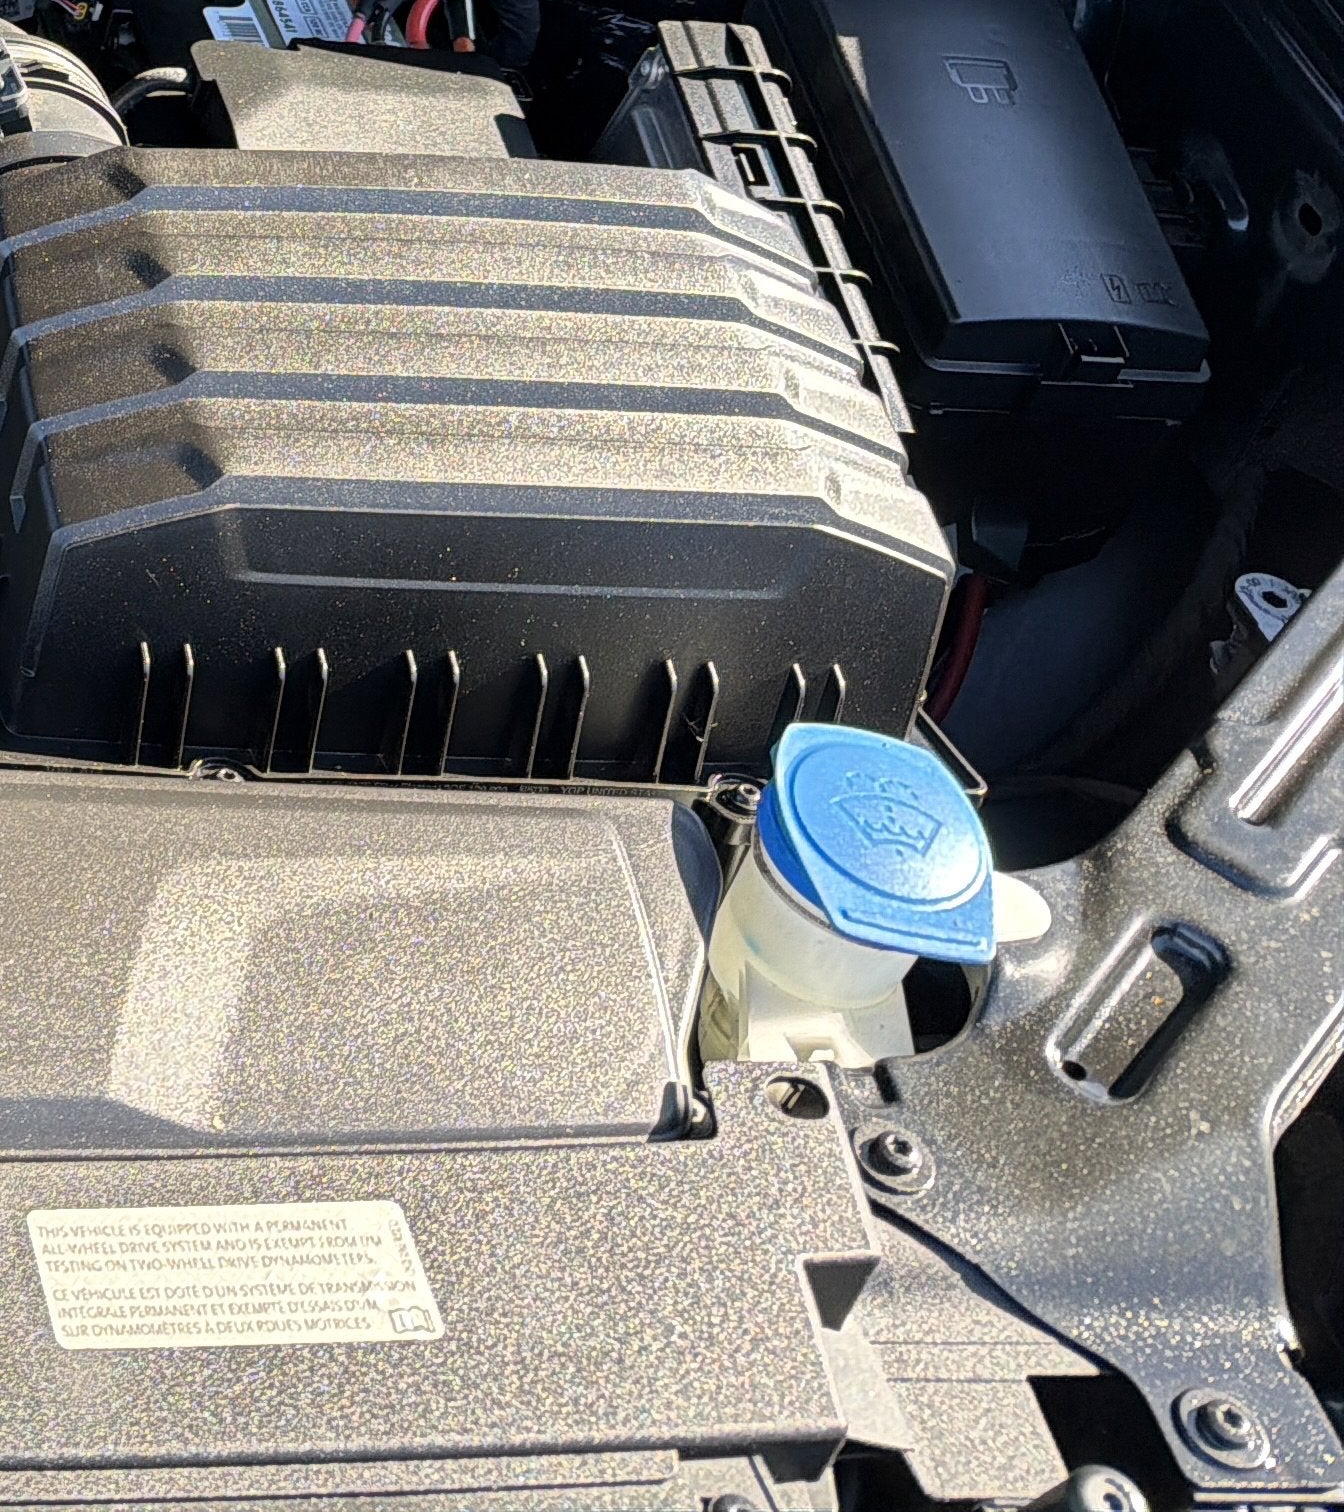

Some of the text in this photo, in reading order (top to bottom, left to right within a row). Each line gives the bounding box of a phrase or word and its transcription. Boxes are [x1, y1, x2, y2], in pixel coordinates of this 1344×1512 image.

[37, 1218, 348, 1239] THIS VEHICLE IS EQUIPPED WITH A PERMANENT
[42, 1241, 118, 1256] ALL-WHEEL
[119, 1241, 161, 1255] DRIVE
[162, 1240, 213, 1254] SYSTEM
[216, 1238, 247, 1252] AND
[248, 1238, 262, 1251] IS
[45, 1259, 103, 1274] TESTING
[105, 1259, 128, 1272] ON
[128, 1257, 216, 1272] TWO-WHEEL
[218, 1255, 260, 1270] DRIVE
[52, 1288, 69, 1302] CE
[139, 1286, 162, 1300] EST
[60, 1324, 90, 1337] SUR
[216, 1319, 253, 1334] DEUX
